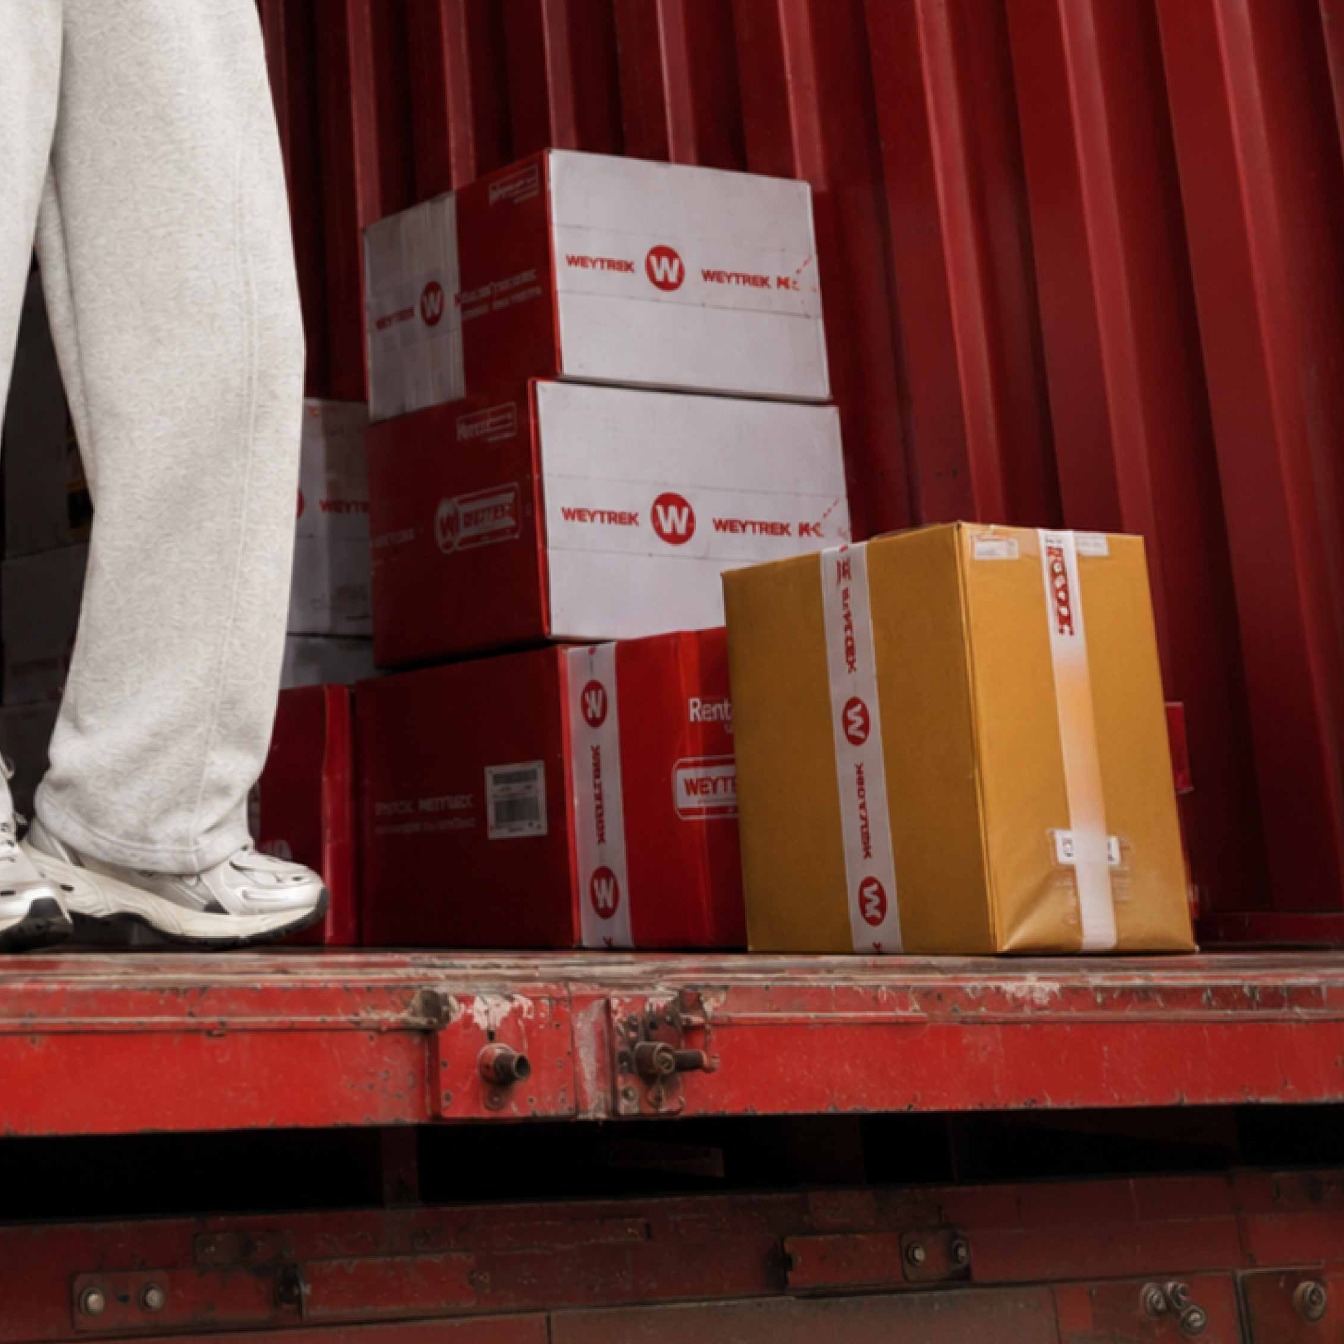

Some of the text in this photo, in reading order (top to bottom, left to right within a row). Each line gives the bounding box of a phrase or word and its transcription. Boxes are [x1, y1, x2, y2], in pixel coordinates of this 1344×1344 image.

[566, 253, 635, 274] WEYTREK
[701, 268, 772, 290] WEYTREK
[561, 506, 640, 527] WEYTREK
[712, 517, 793, 538] WEYTREK
